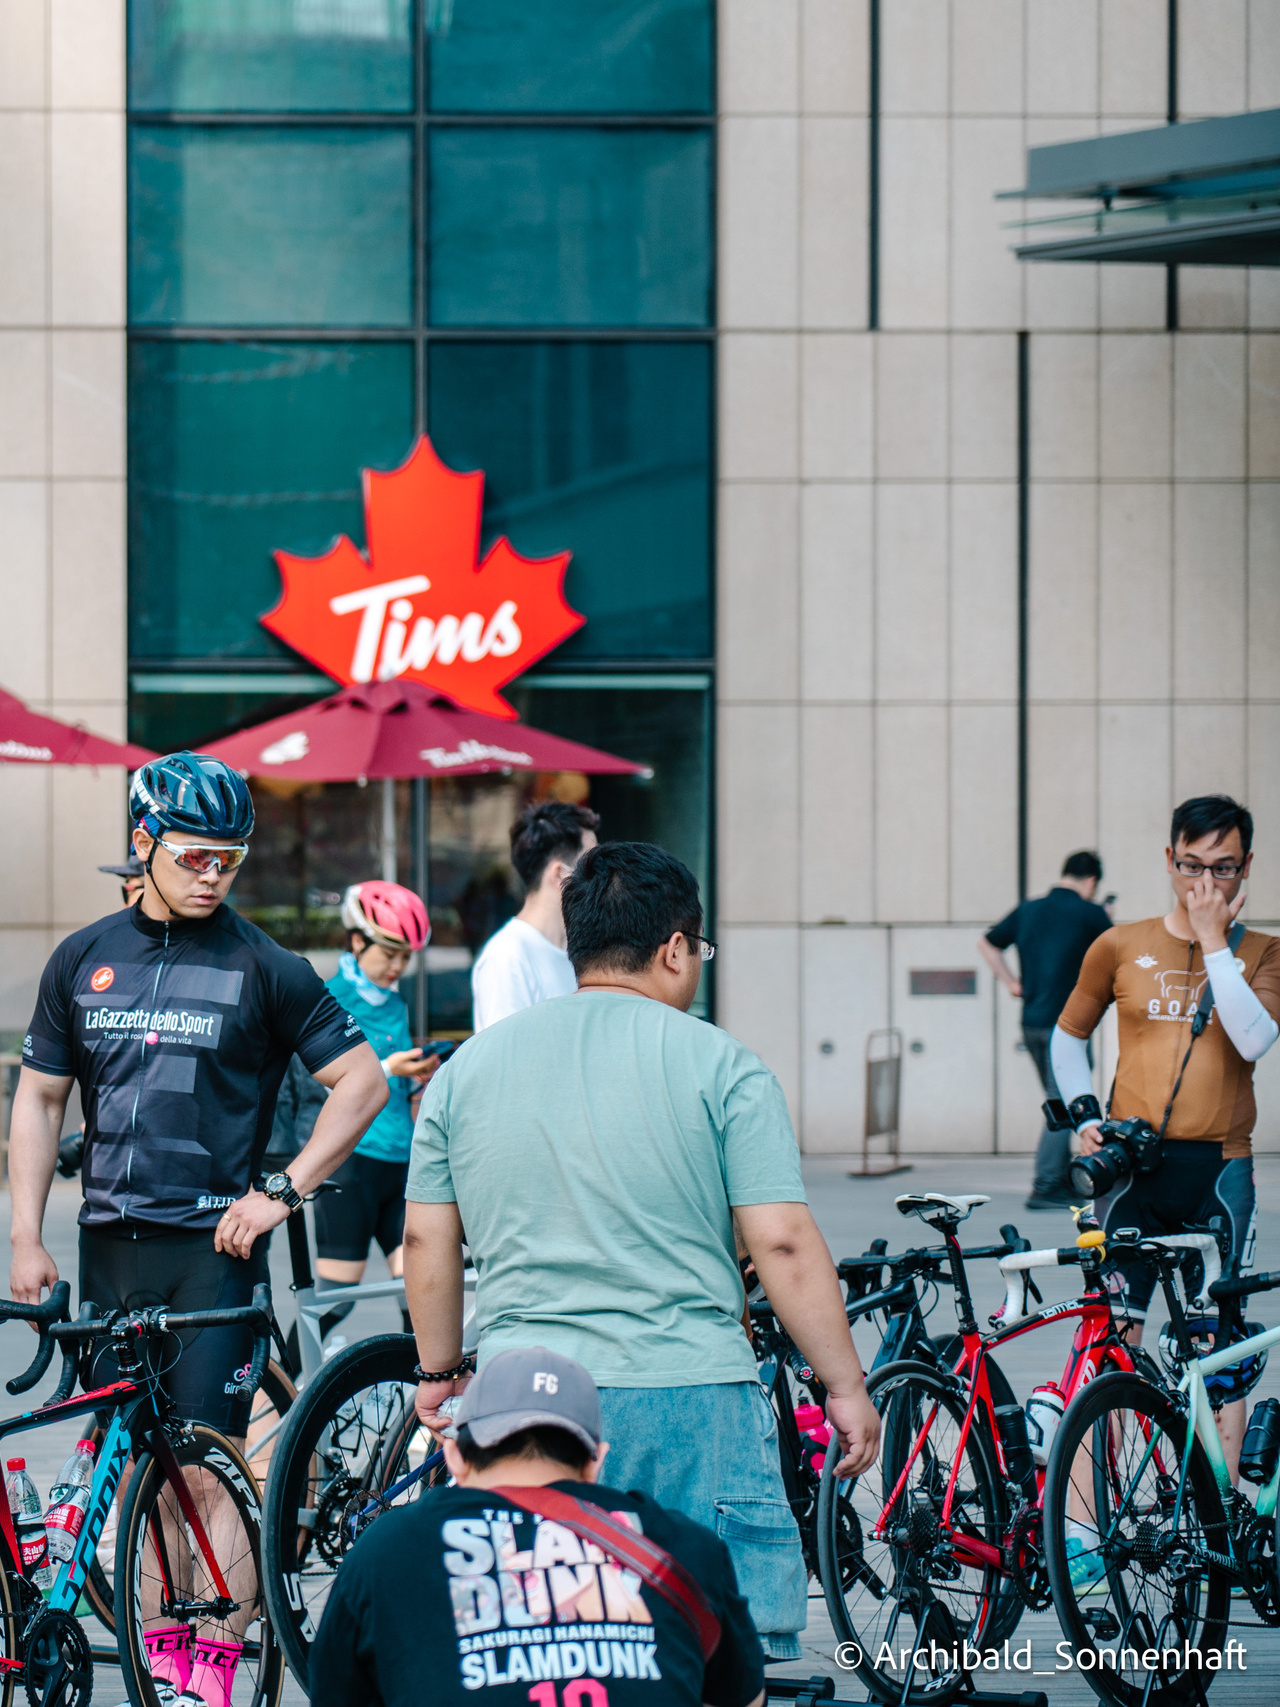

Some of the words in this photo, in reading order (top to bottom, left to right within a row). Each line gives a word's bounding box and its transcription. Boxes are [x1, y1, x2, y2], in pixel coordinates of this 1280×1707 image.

[329, 574, 521, 682] Tims
[104, 1032, 123, 1040] Tutto
[124, 1032, 129, 1040] il
[160, 1035, 176, 1043] della
[178, 1037, 192, 1045] vita
[482, 1509, 524, 1525] THE
[449, 1563, 654, 1638] DUNK
[458, 1627, 553, 1655] SAKURAGI
[554, 1624, 656, 1643] HANAMICHI
[460, 1641, 663, 1691] SLAMDUNK
